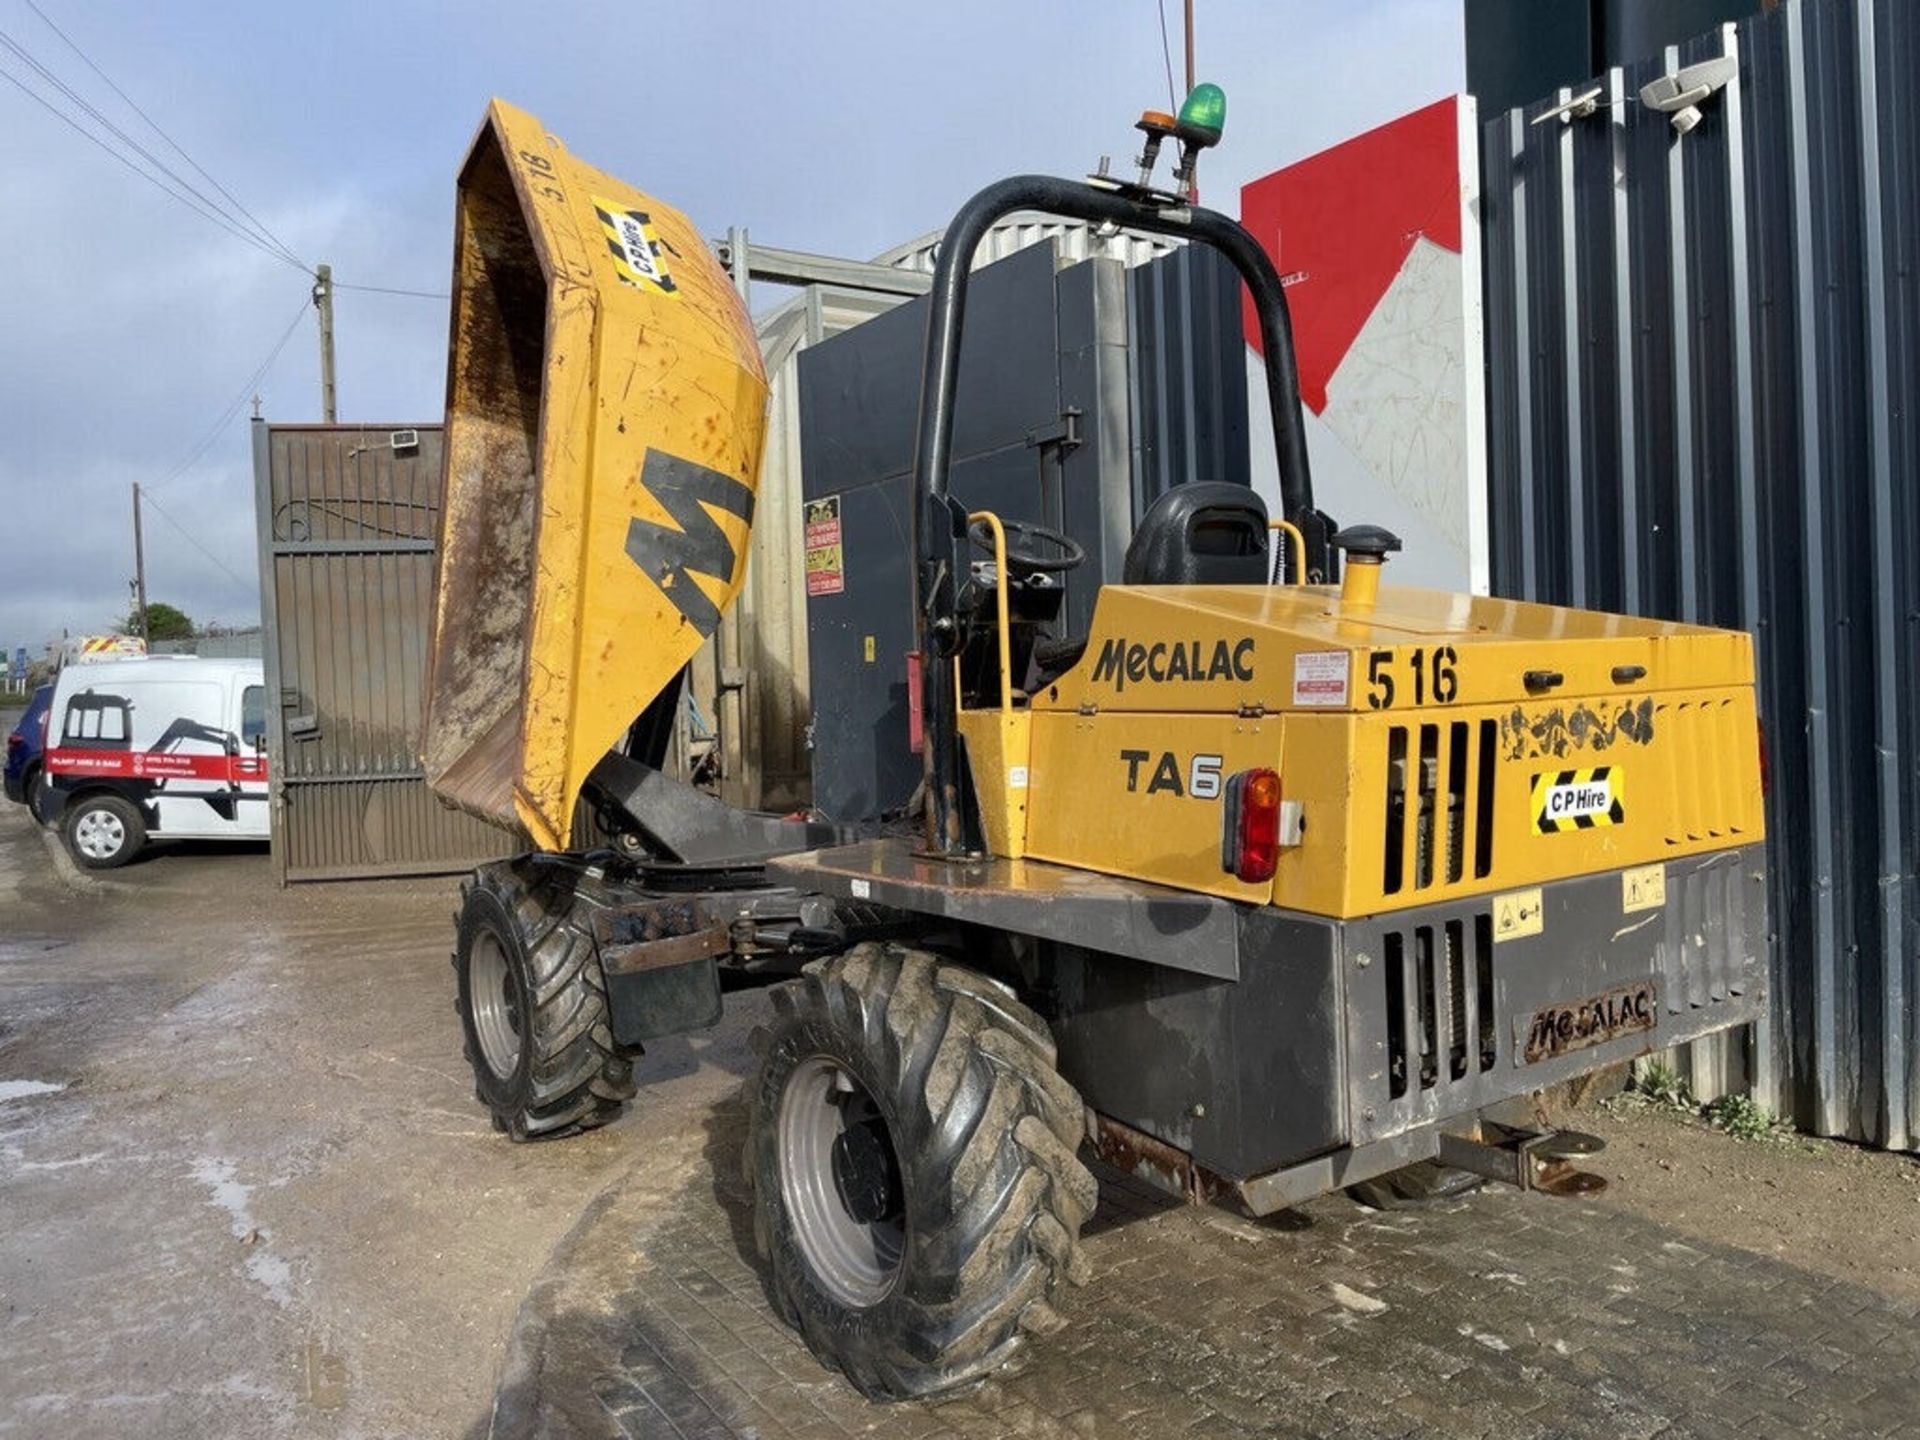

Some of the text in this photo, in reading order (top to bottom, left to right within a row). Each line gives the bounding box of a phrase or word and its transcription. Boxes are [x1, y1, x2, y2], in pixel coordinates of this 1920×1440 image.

[519, 151, 565, 203] 516
[1368, 646, 1458, 710] 516
[1120, 749, 1223, 800] TA6
